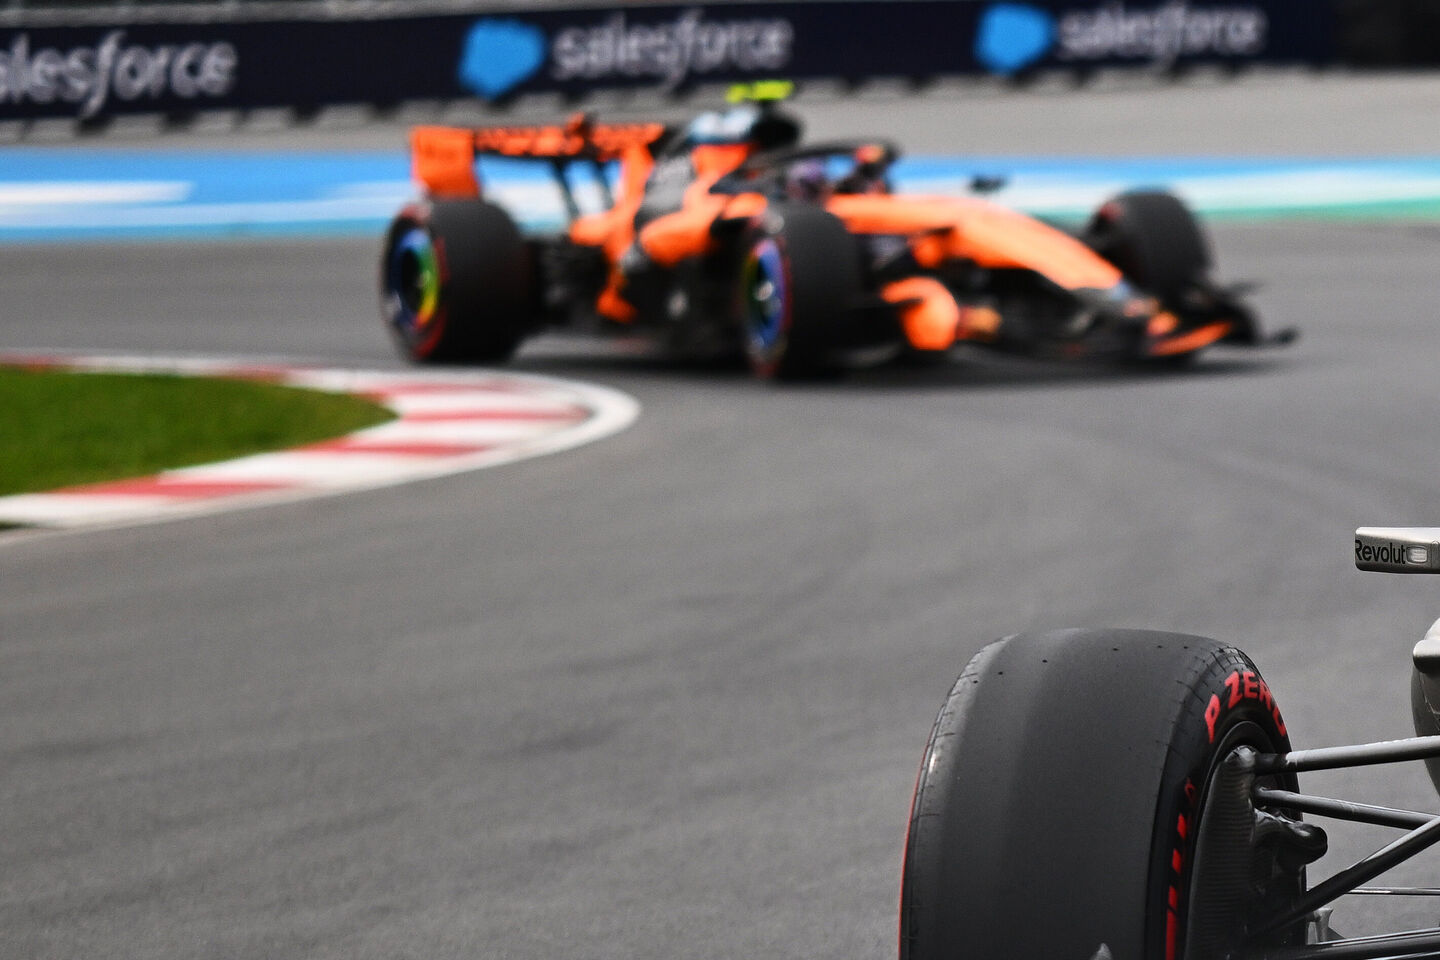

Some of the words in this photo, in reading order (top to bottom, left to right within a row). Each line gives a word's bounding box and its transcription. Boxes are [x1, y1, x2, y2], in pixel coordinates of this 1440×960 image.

[0, 30, 238, 118] lesforce
[1355, 539, 1406, 565] Revolut
[1224, 670, 1287, 737] ZERO
